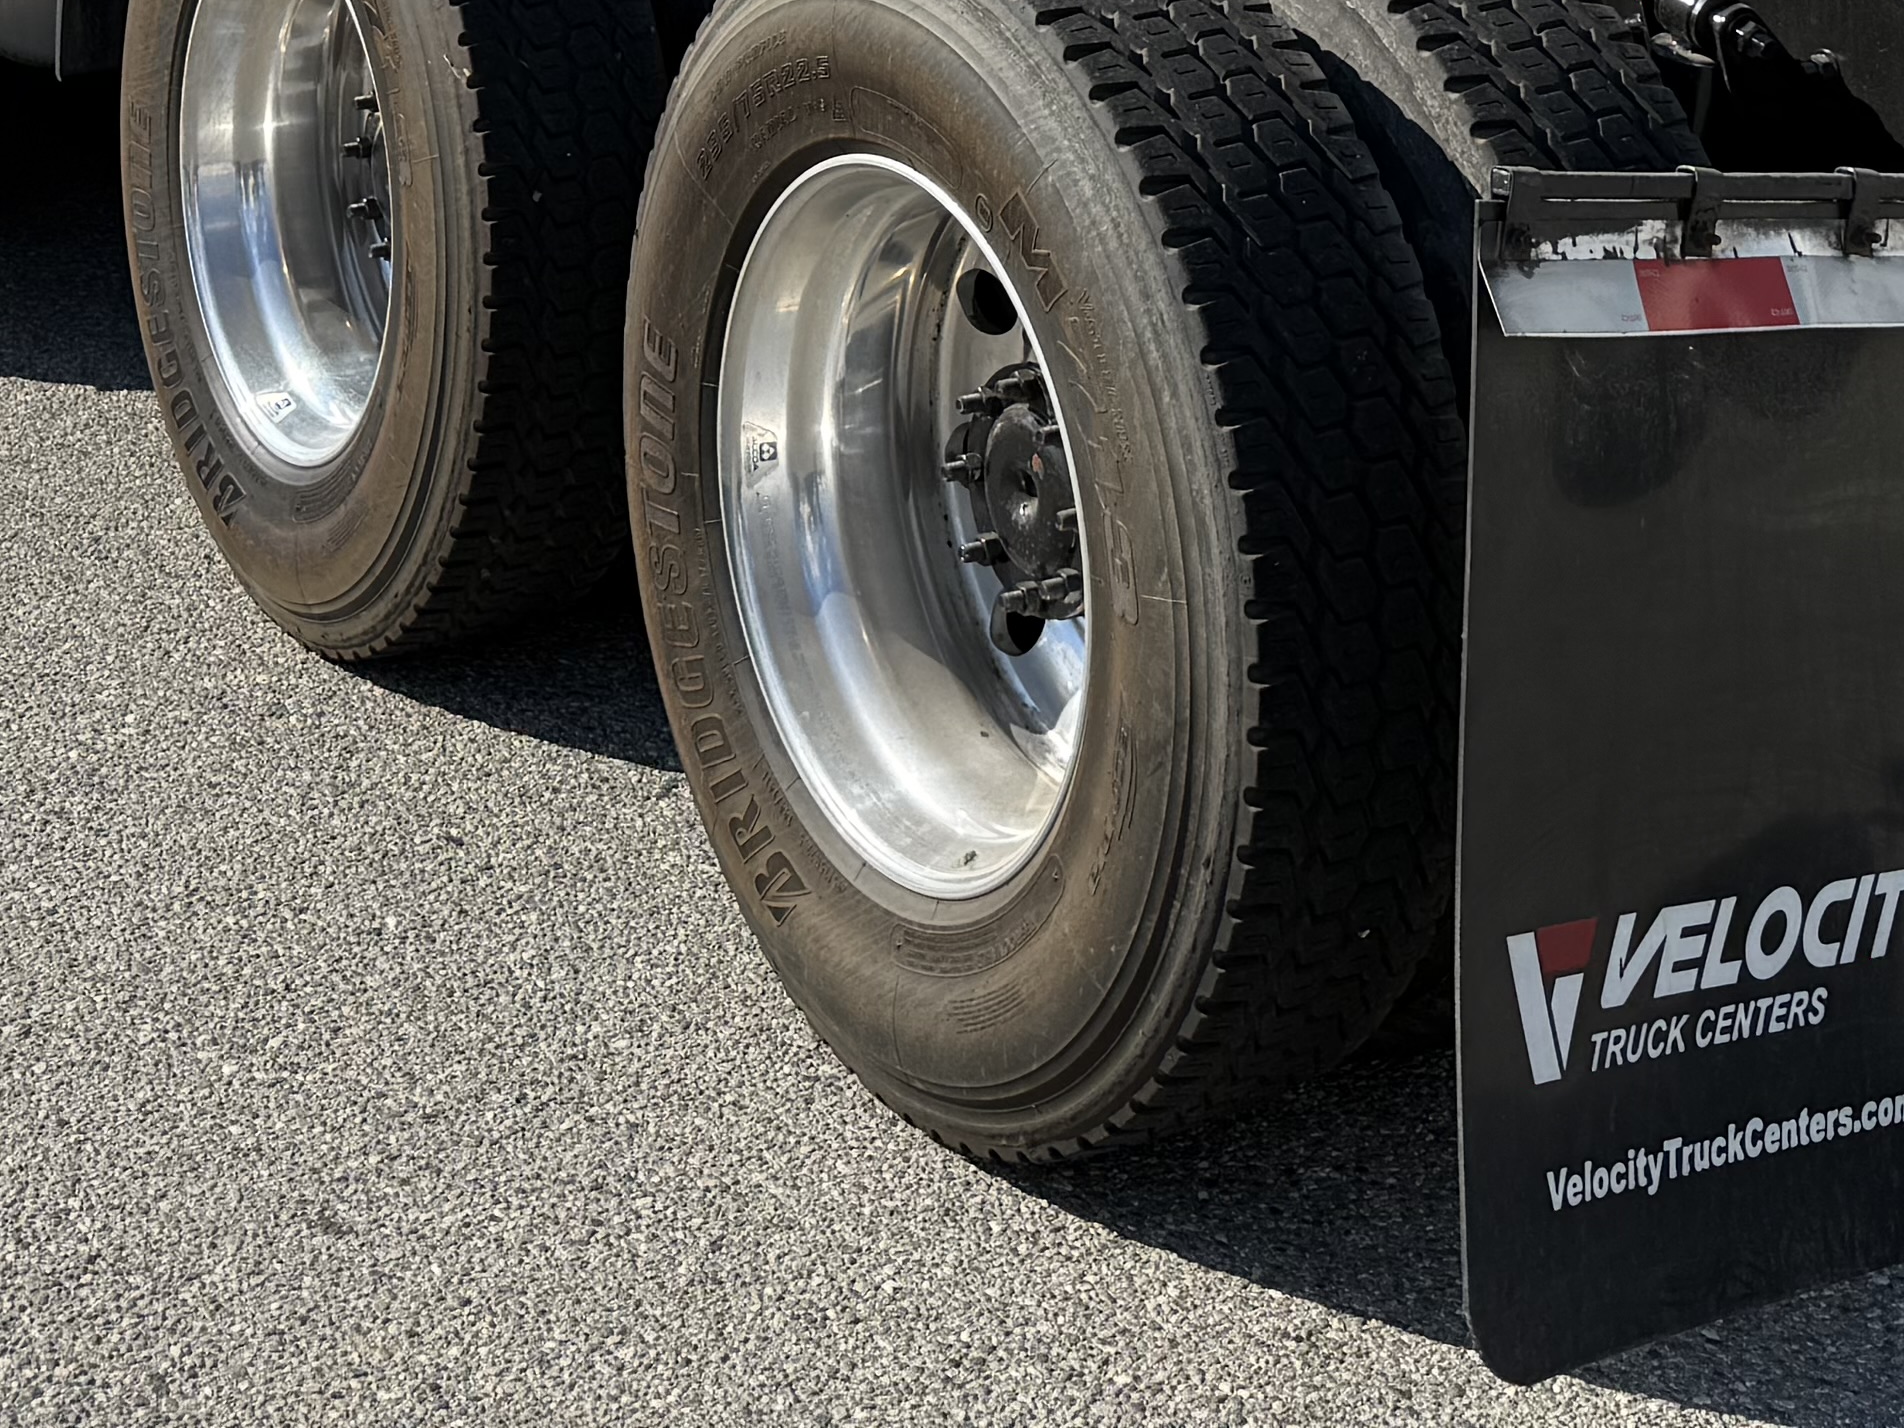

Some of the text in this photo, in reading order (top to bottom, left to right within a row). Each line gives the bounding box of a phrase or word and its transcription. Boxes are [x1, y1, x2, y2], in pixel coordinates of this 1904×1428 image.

[128, 95, 247, 528] BRIDGESTONE
[639, 320, 811, 929] BRIDGESTONE
[1590, 987, 1828, 1072] TRUCK CENTERS
